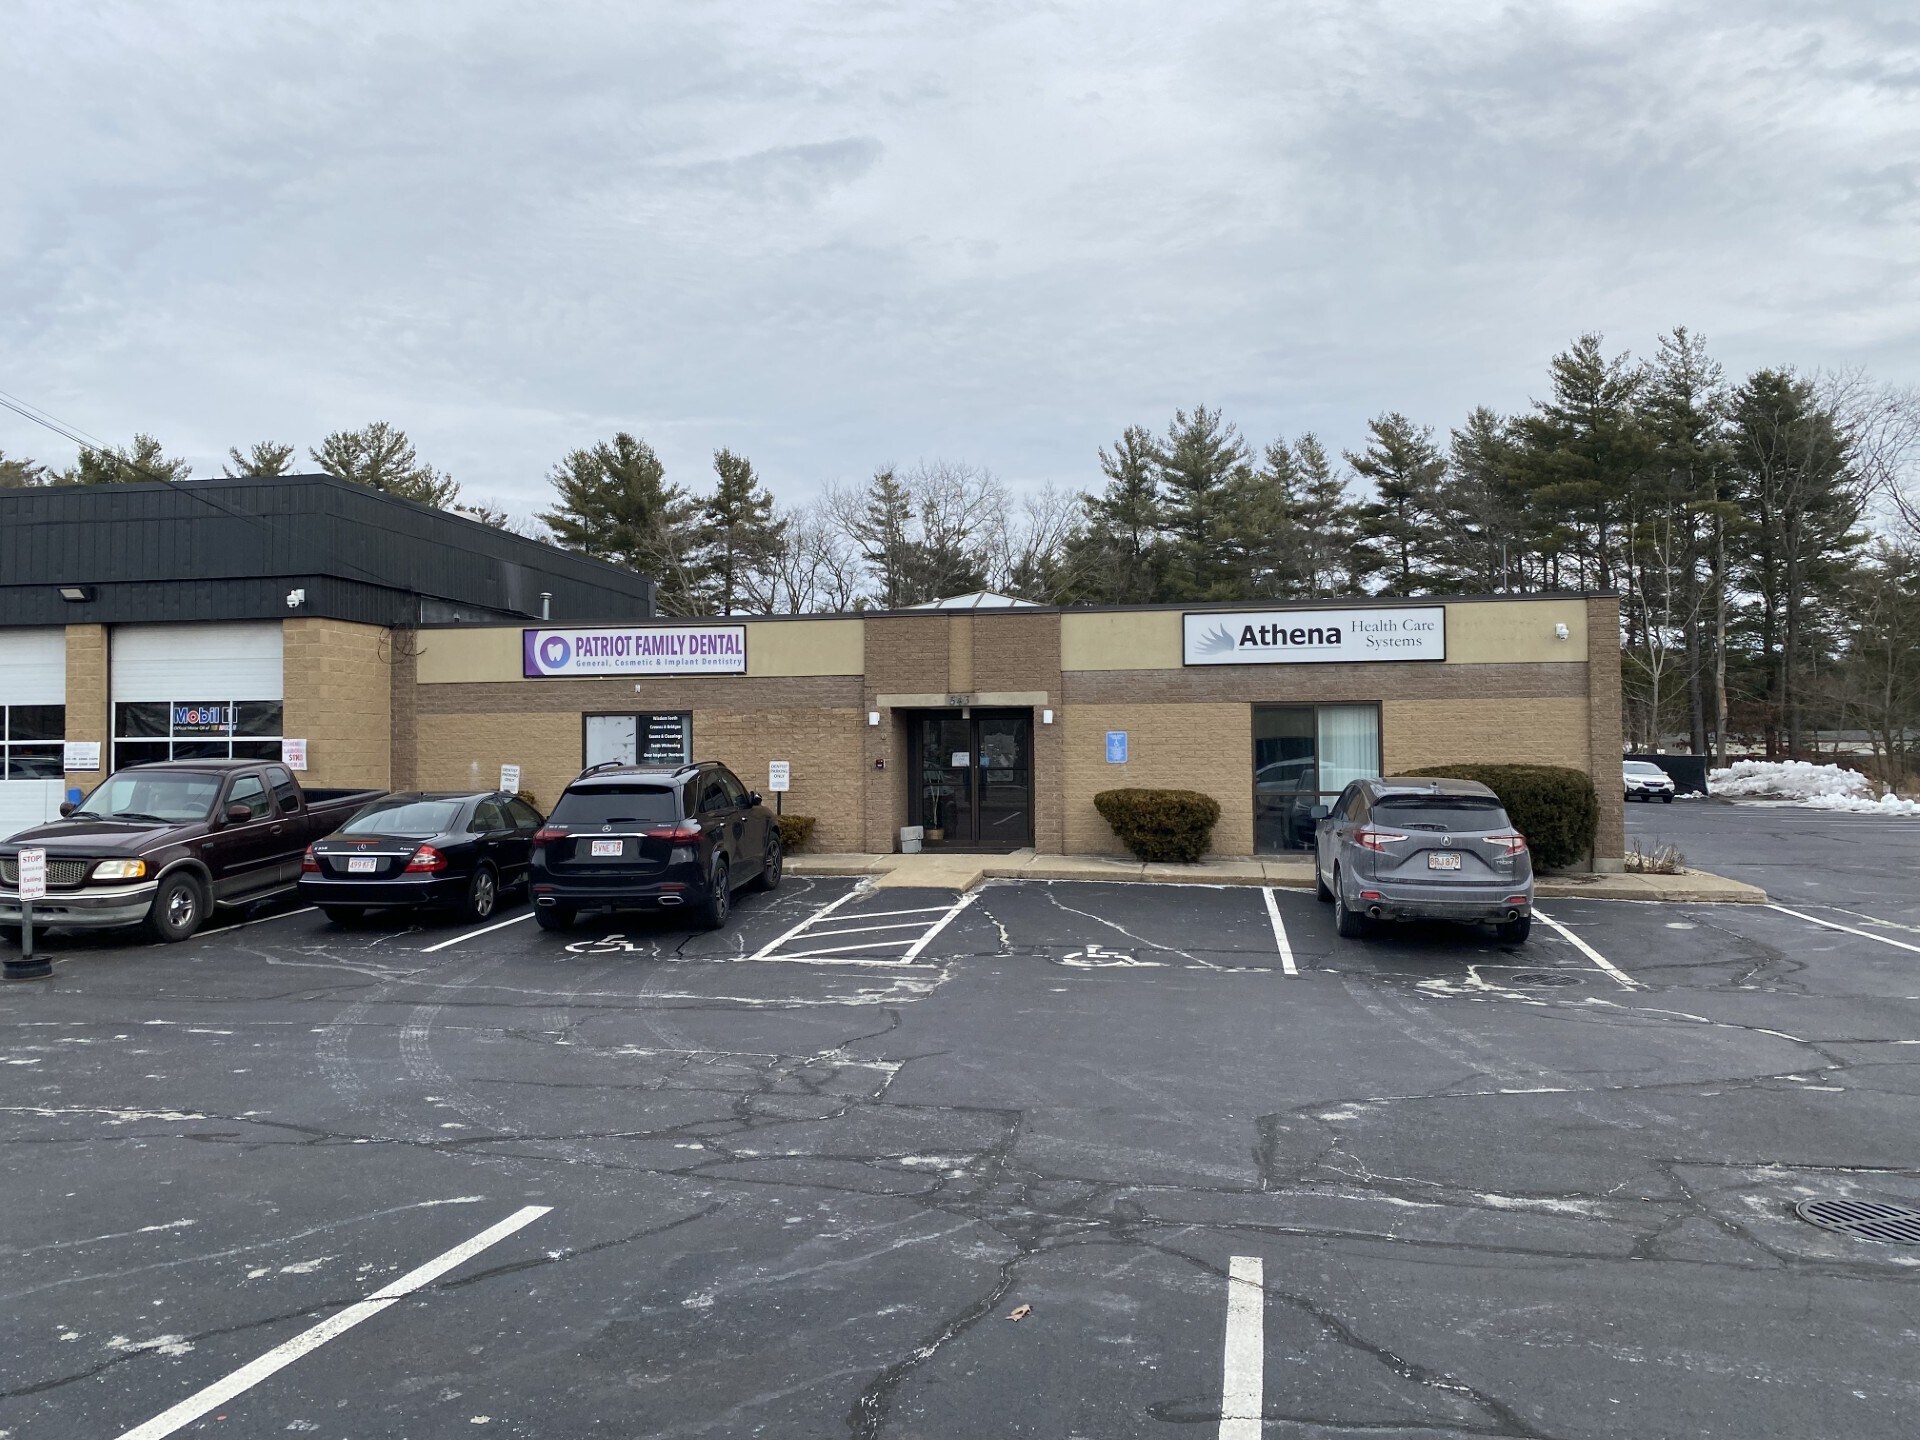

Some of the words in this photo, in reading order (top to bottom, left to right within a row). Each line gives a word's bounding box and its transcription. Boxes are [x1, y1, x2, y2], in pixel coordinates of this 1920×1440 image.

[1351, 619, 1397, 633] Health
[1402, 618, 1435, 632] Care
[1239, 623, 1342, 646] Athena
[1366, 634, 1423, 651] Systems
[576, 635, 632, 657] PATRIOT
[635, 634, 686, 656] FAMILY
[689, 634, 743, 655] DENTAL
[576, 659, 612, 668] General,
[615, 658, 653, 666] Cosmetic
[655, 658, 661, 666] &
[664, 657, 699, 667] Implant
[702, 657, 742, 667] Dentistry
[173, 706, 220, 724] Mobil
